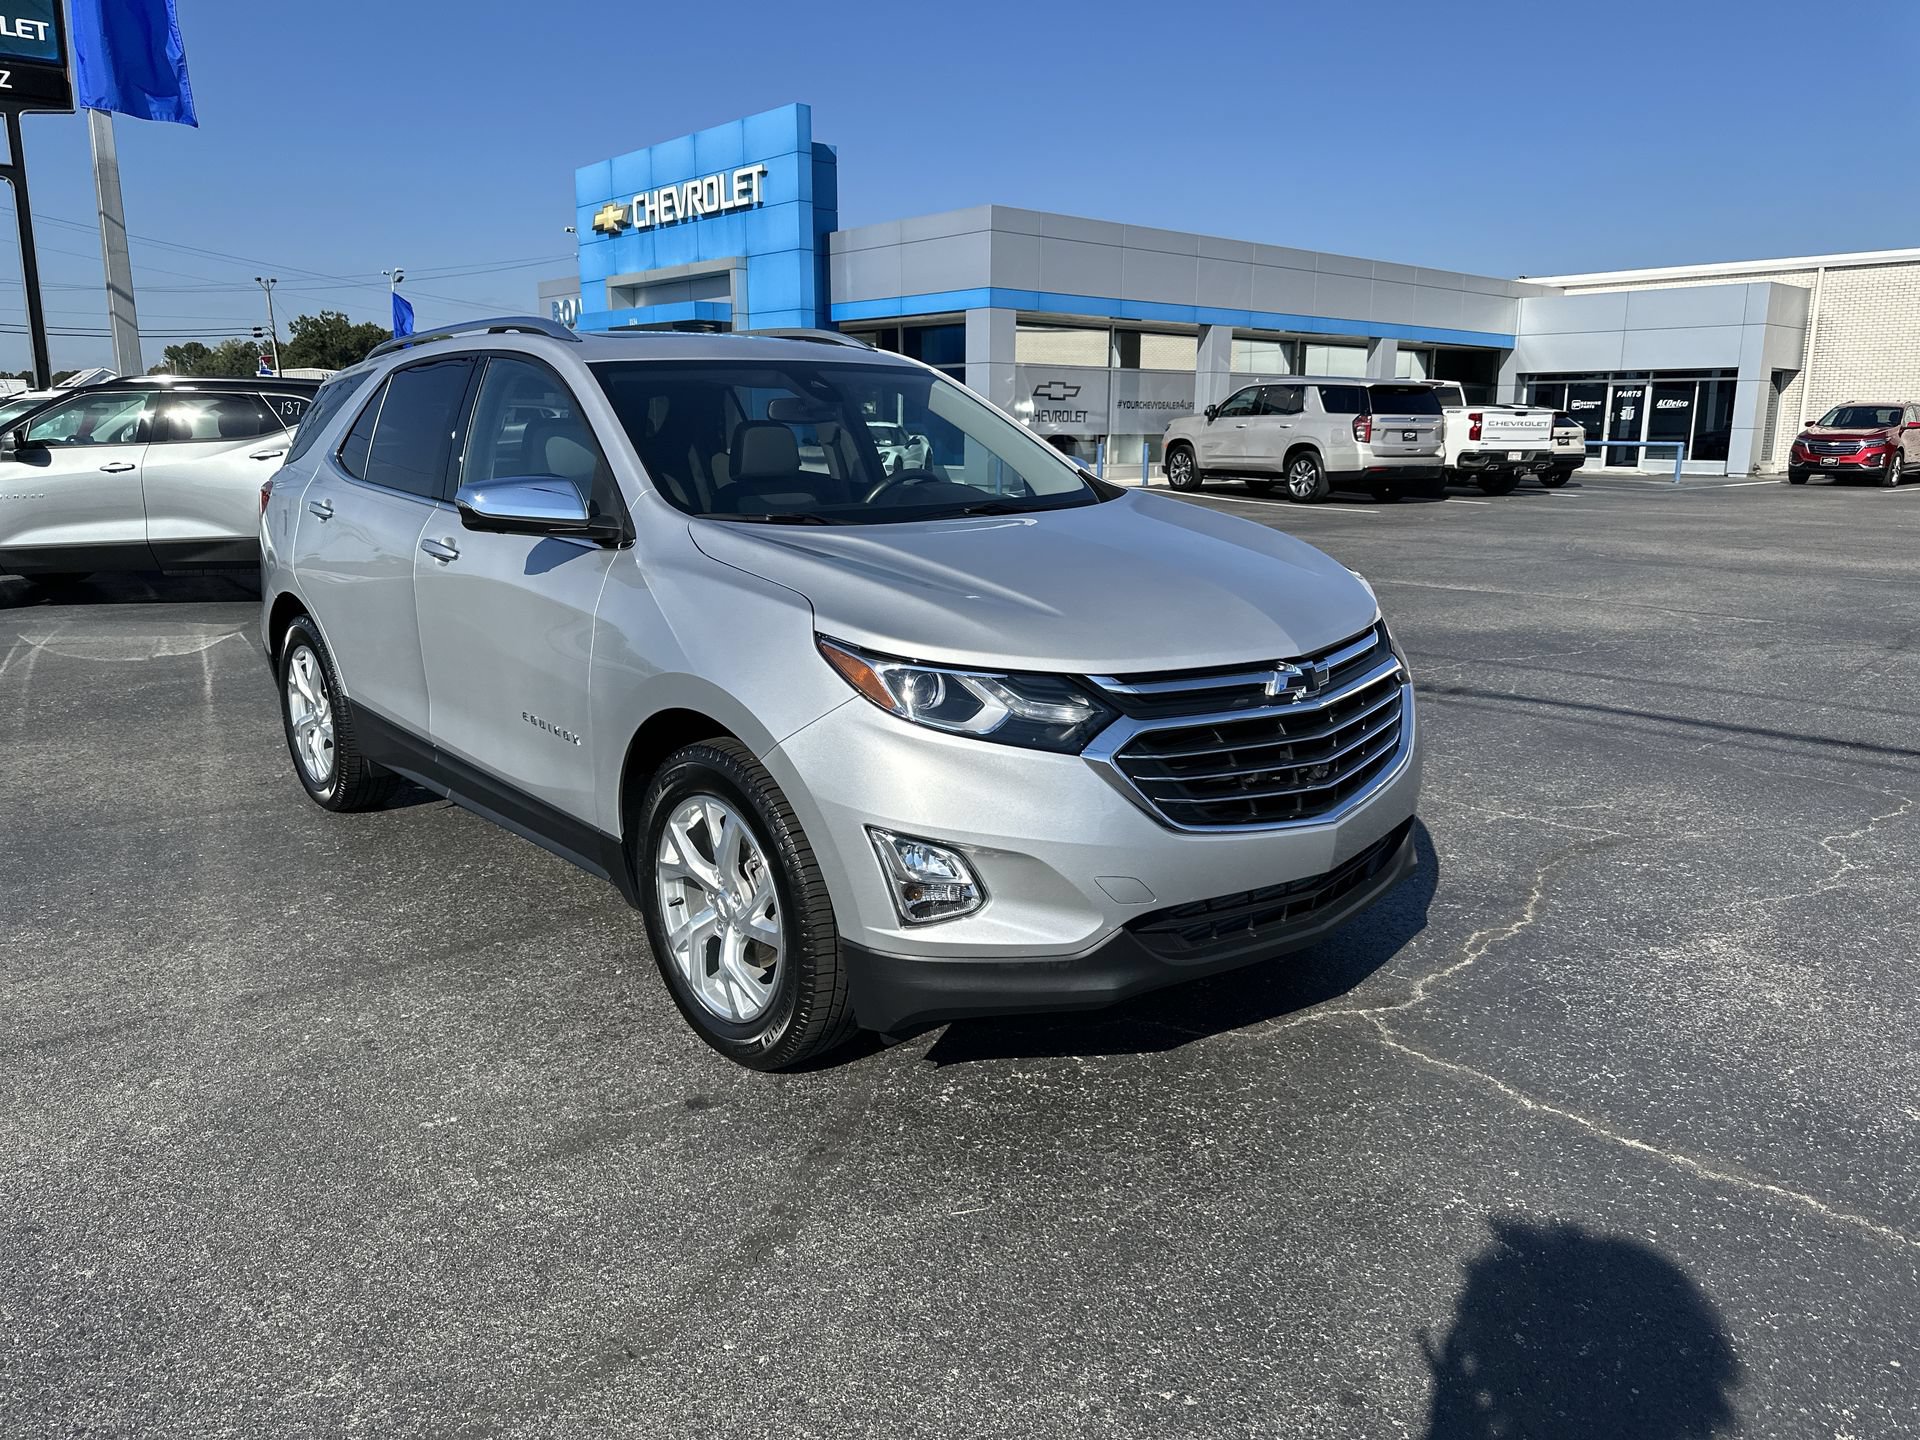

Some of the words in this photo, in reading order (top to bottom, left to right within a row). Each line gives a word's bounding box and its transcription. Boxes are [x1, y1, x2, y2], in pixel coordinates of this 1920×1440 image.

[0, 16, 49, 40] LET
[632, 163, 767, 229] CHEVROLET
[1616, 390, 1643, 398] PARTS
[280, 401, 301, 416] 137
[1656, 399, 1689, 408] ACDelco
[1026, 409, 1088, 423] HEVROLET
[522, 711, 581, 746] EQUINOX
